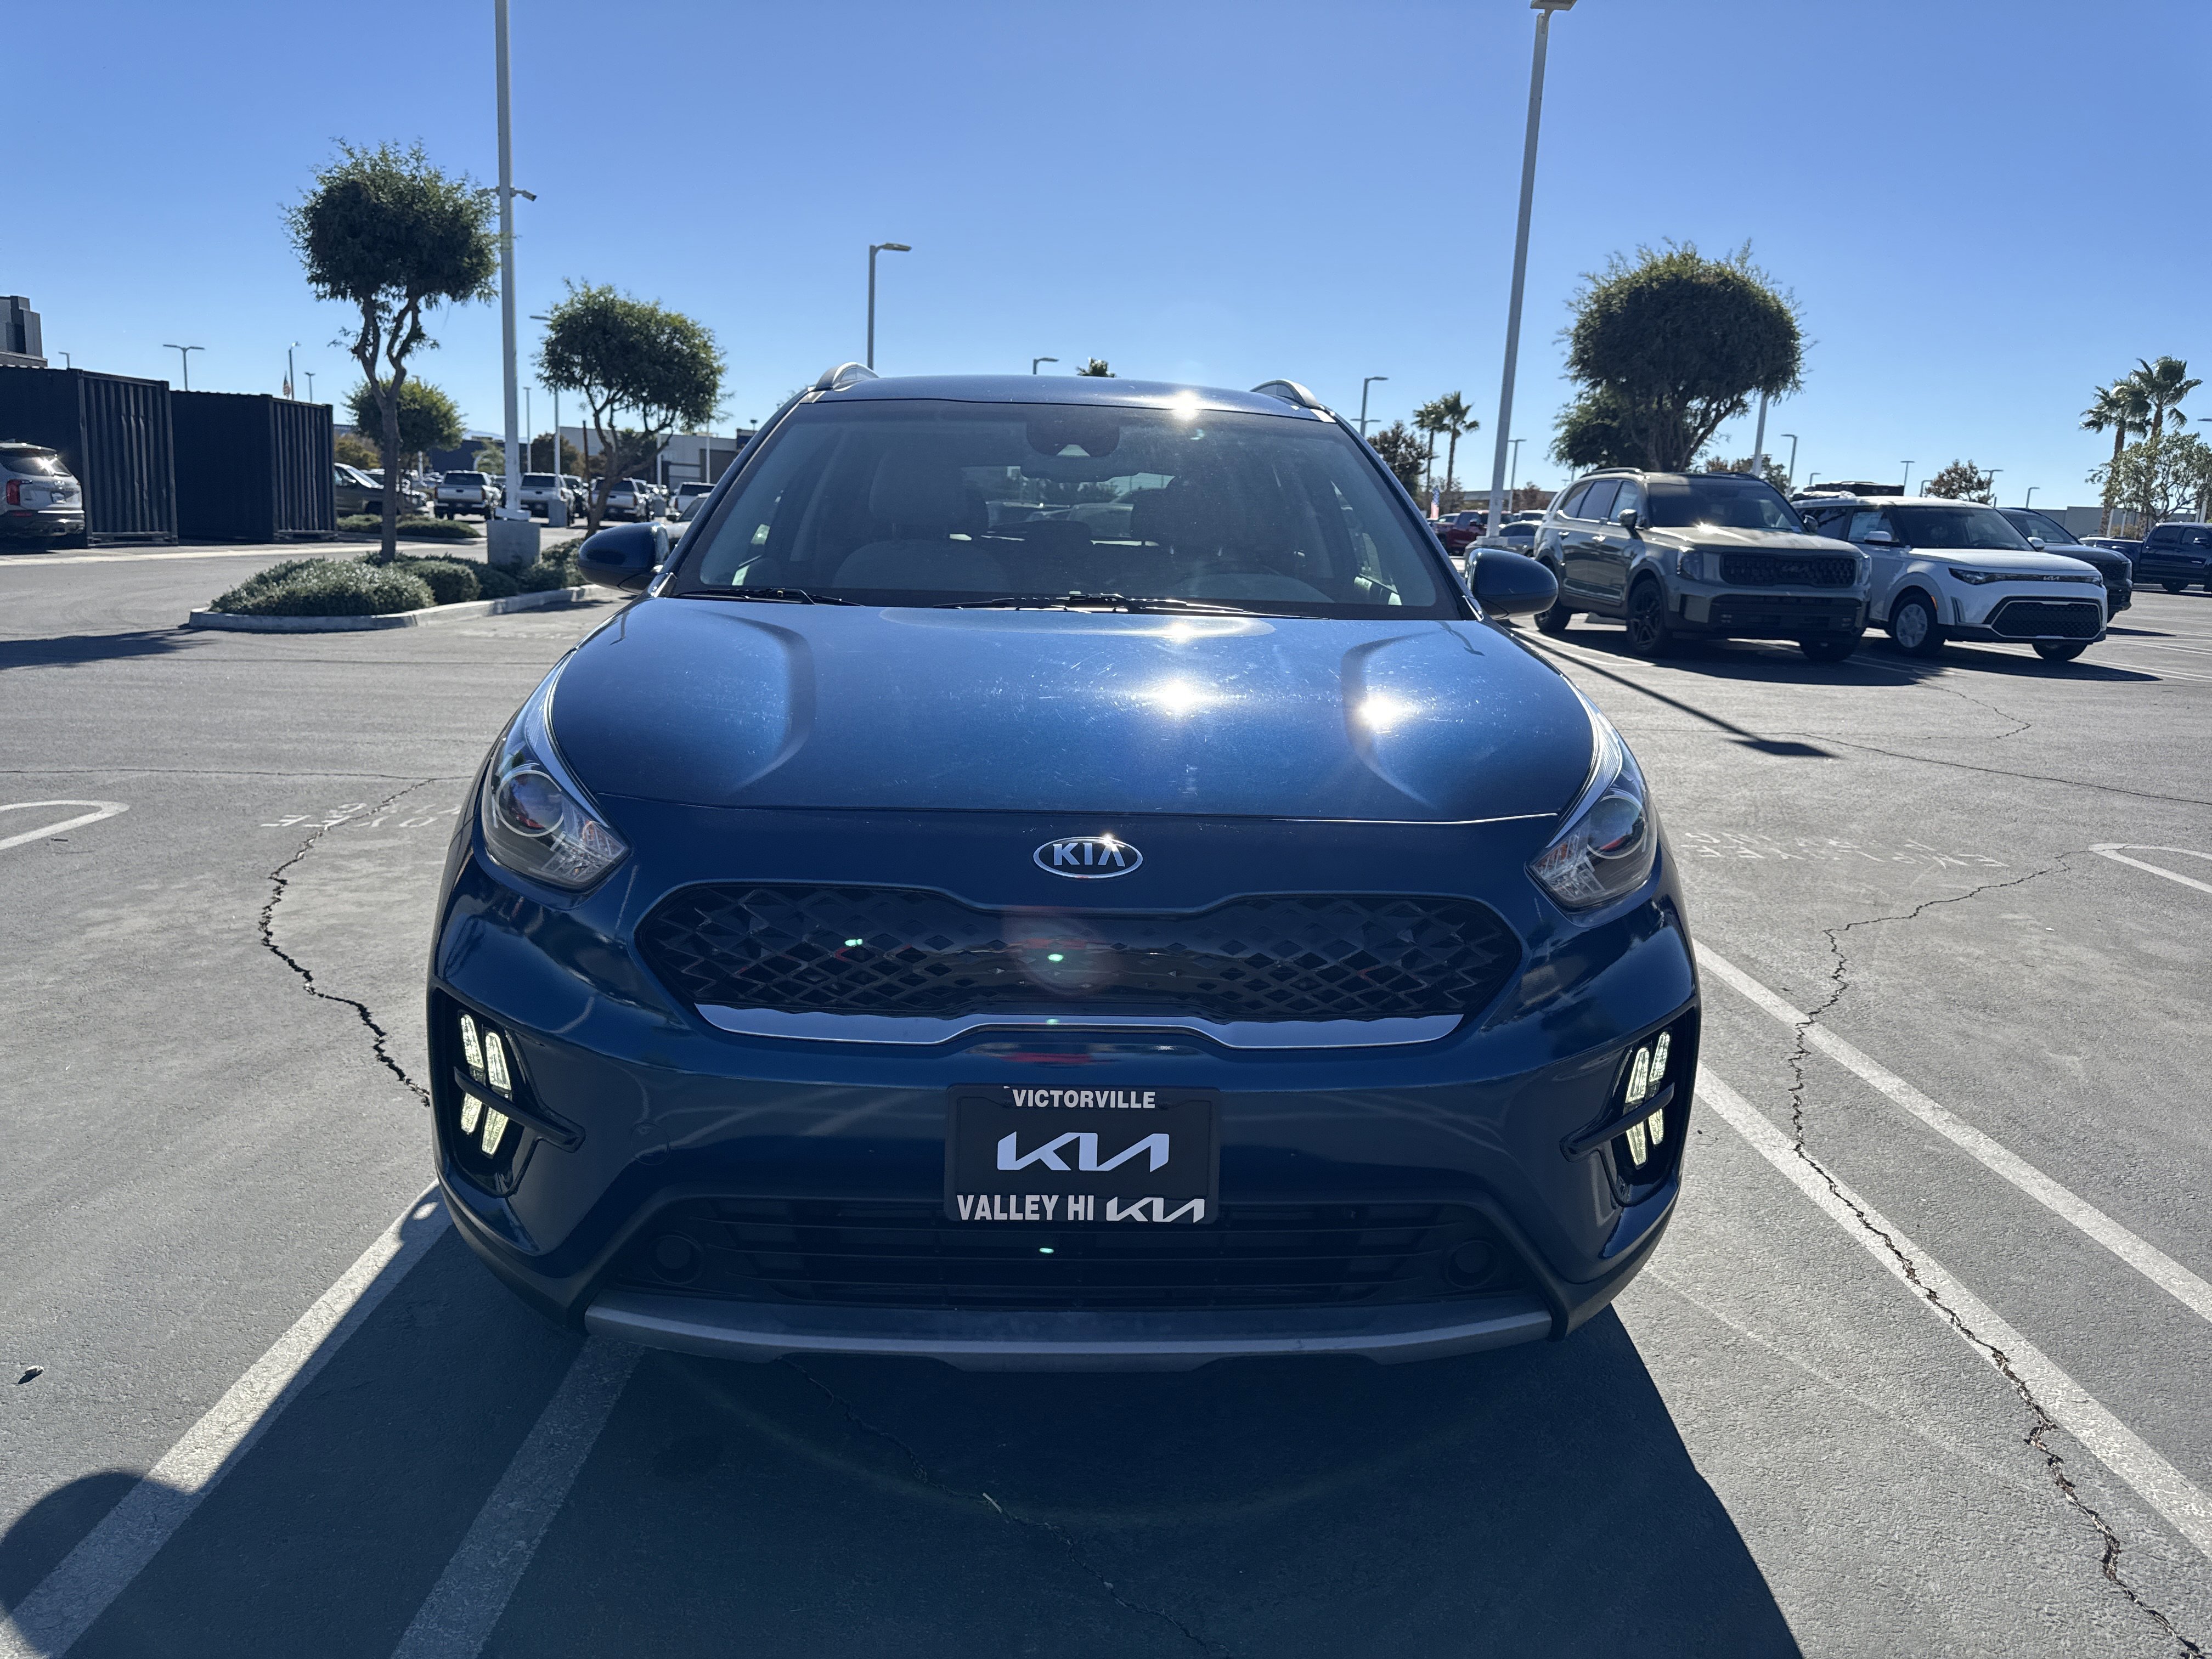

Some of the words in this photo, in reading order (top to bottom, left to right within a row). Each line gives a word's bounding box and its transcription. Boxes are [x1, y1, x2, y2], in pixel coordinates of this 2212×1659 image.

[1052, 843, 1126, 867] KIA
[1012, 1089, 1155, 1109] VICTORVILLE
[997, 1131, 1170, 1172] KIA
[957, 1194, 1059, 1221] VALLEY
[1067, 1195, 1094, 1221] HI
[1105, 1197, 1205, 1223] KIA
